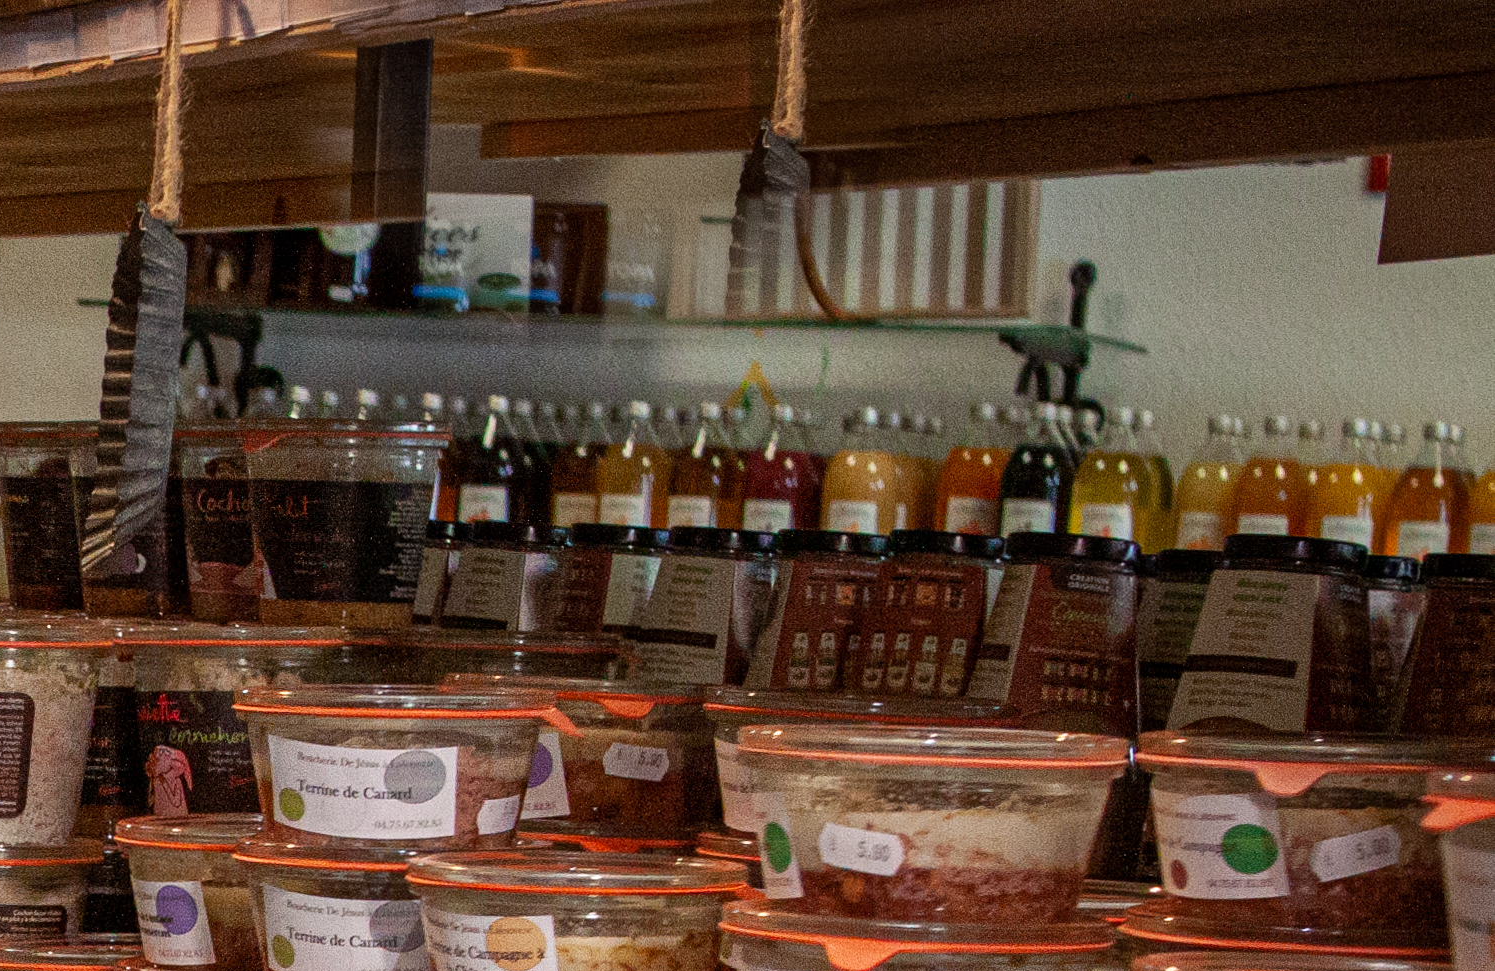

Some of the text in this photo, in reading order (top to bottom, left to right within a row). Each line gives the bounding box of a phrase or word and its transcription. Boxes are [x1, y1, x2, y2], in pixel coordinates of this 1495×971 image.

[297, 777, 413, 801] Terrine de Canard
[287, 924, 398, 949] Terrine de Canard
